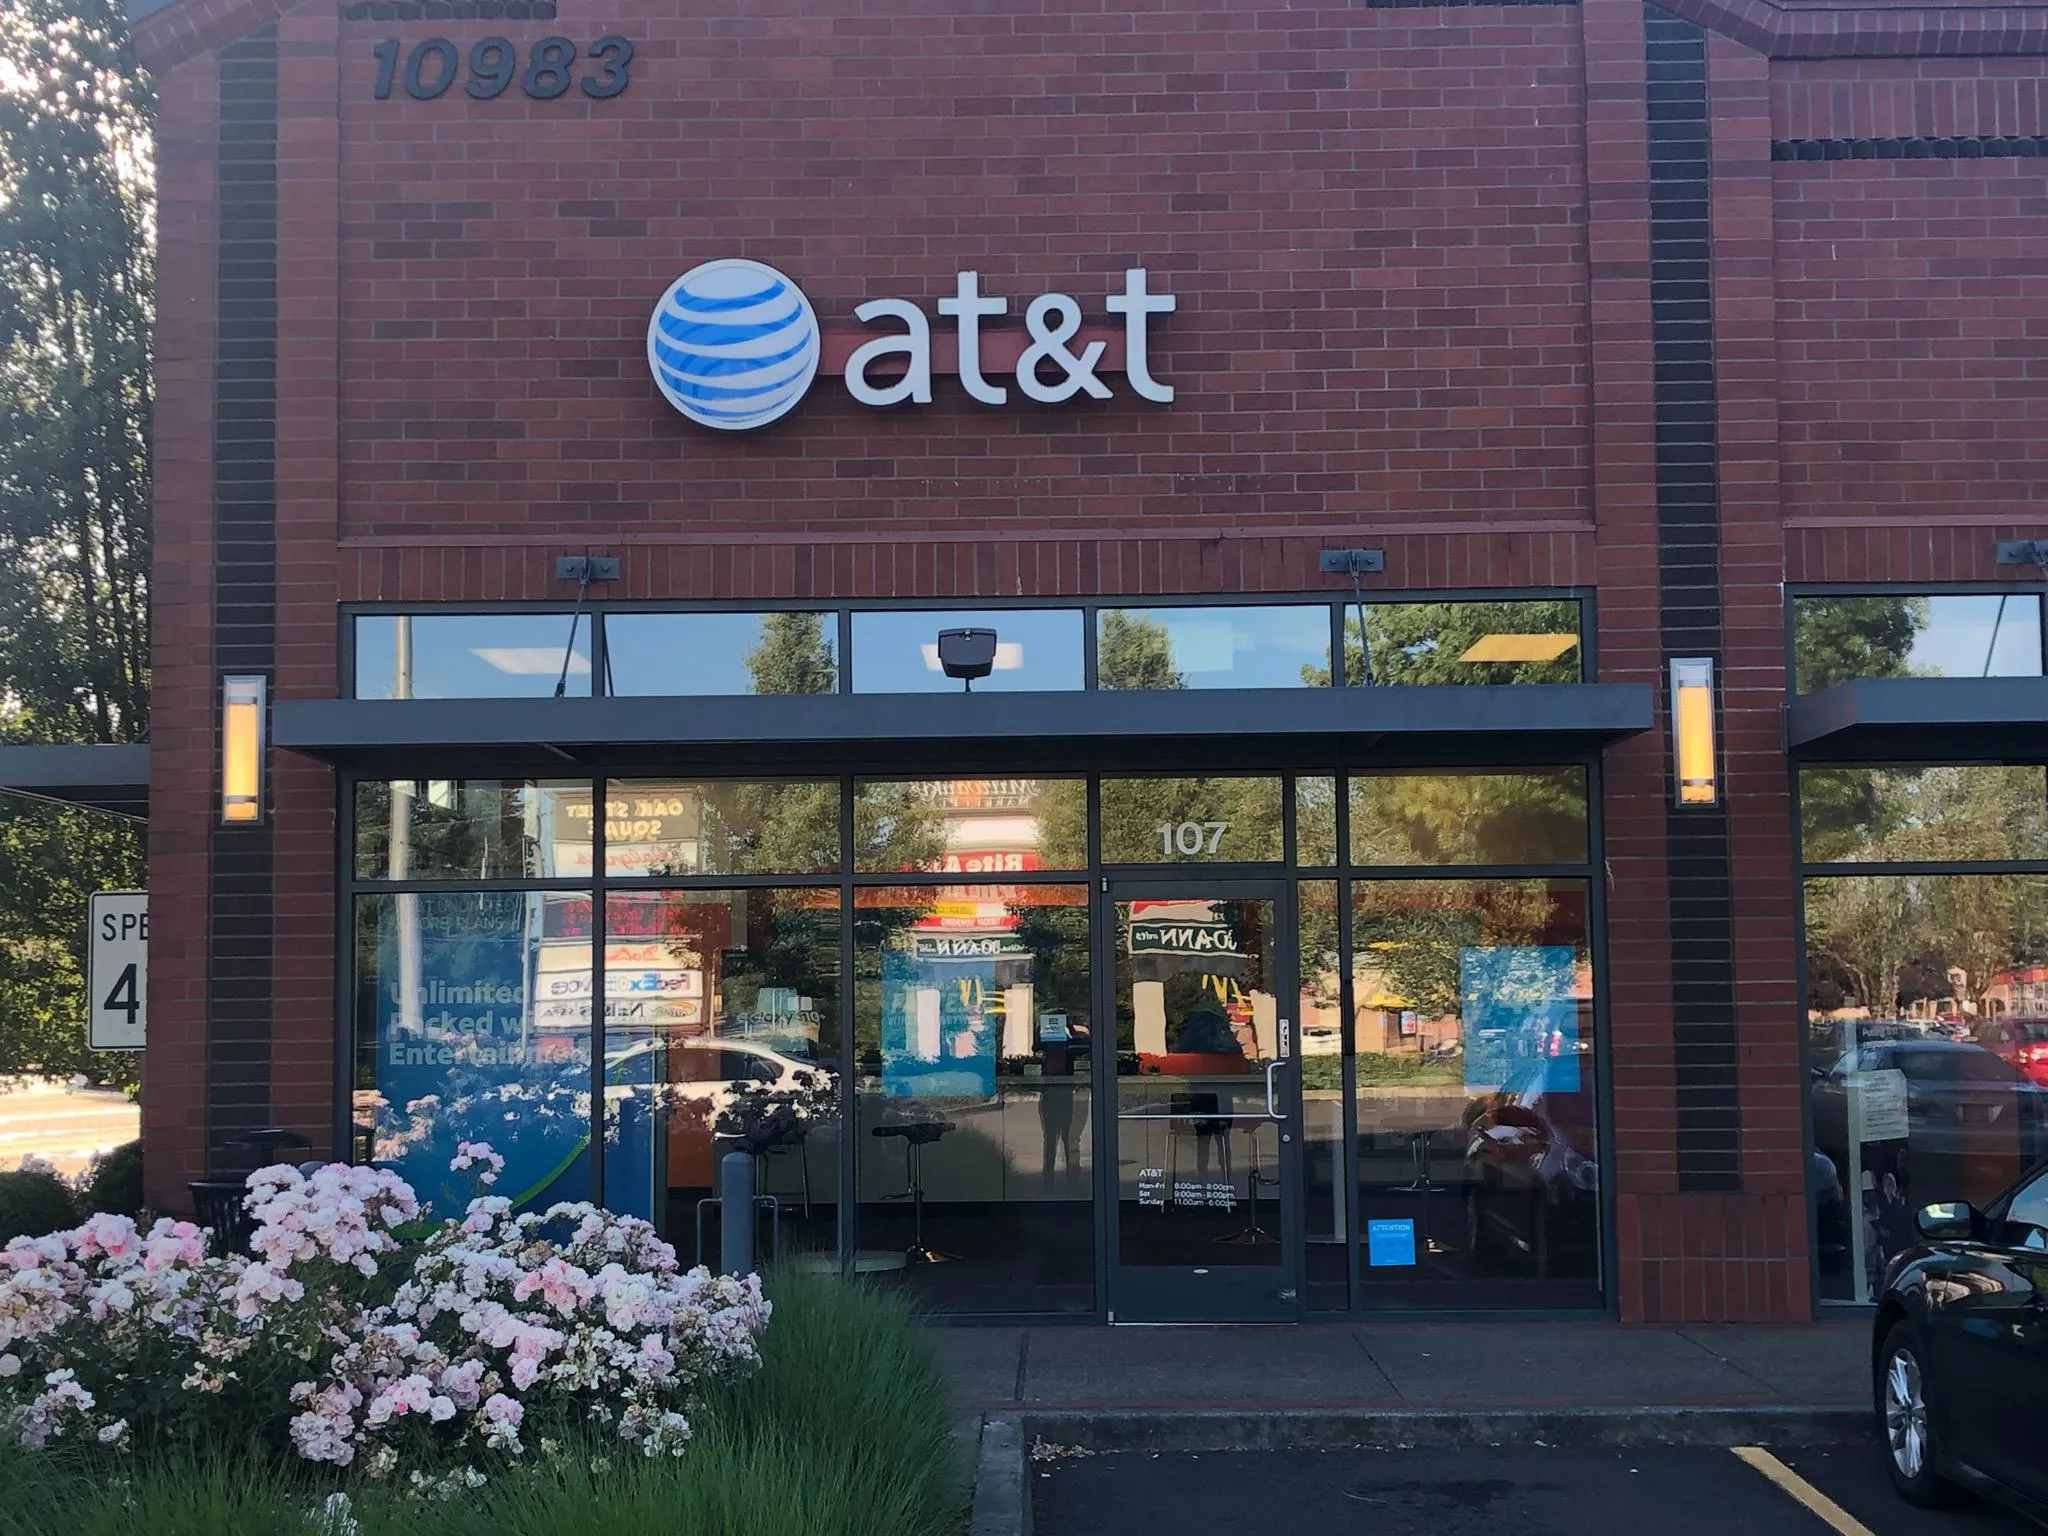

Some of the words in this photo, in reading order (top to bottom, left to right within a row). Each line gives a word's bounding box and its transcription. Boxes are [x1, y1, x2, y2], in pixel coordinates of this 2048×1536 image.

[373, 36, 634, 100] 10983
[844, 268, 1176, 406] at&t
[1157, 822, 1228, 855] 107
[1139, 1168, 1164, 1177] AT&T
[1139, 1198, 1164, 1206] Sunday
